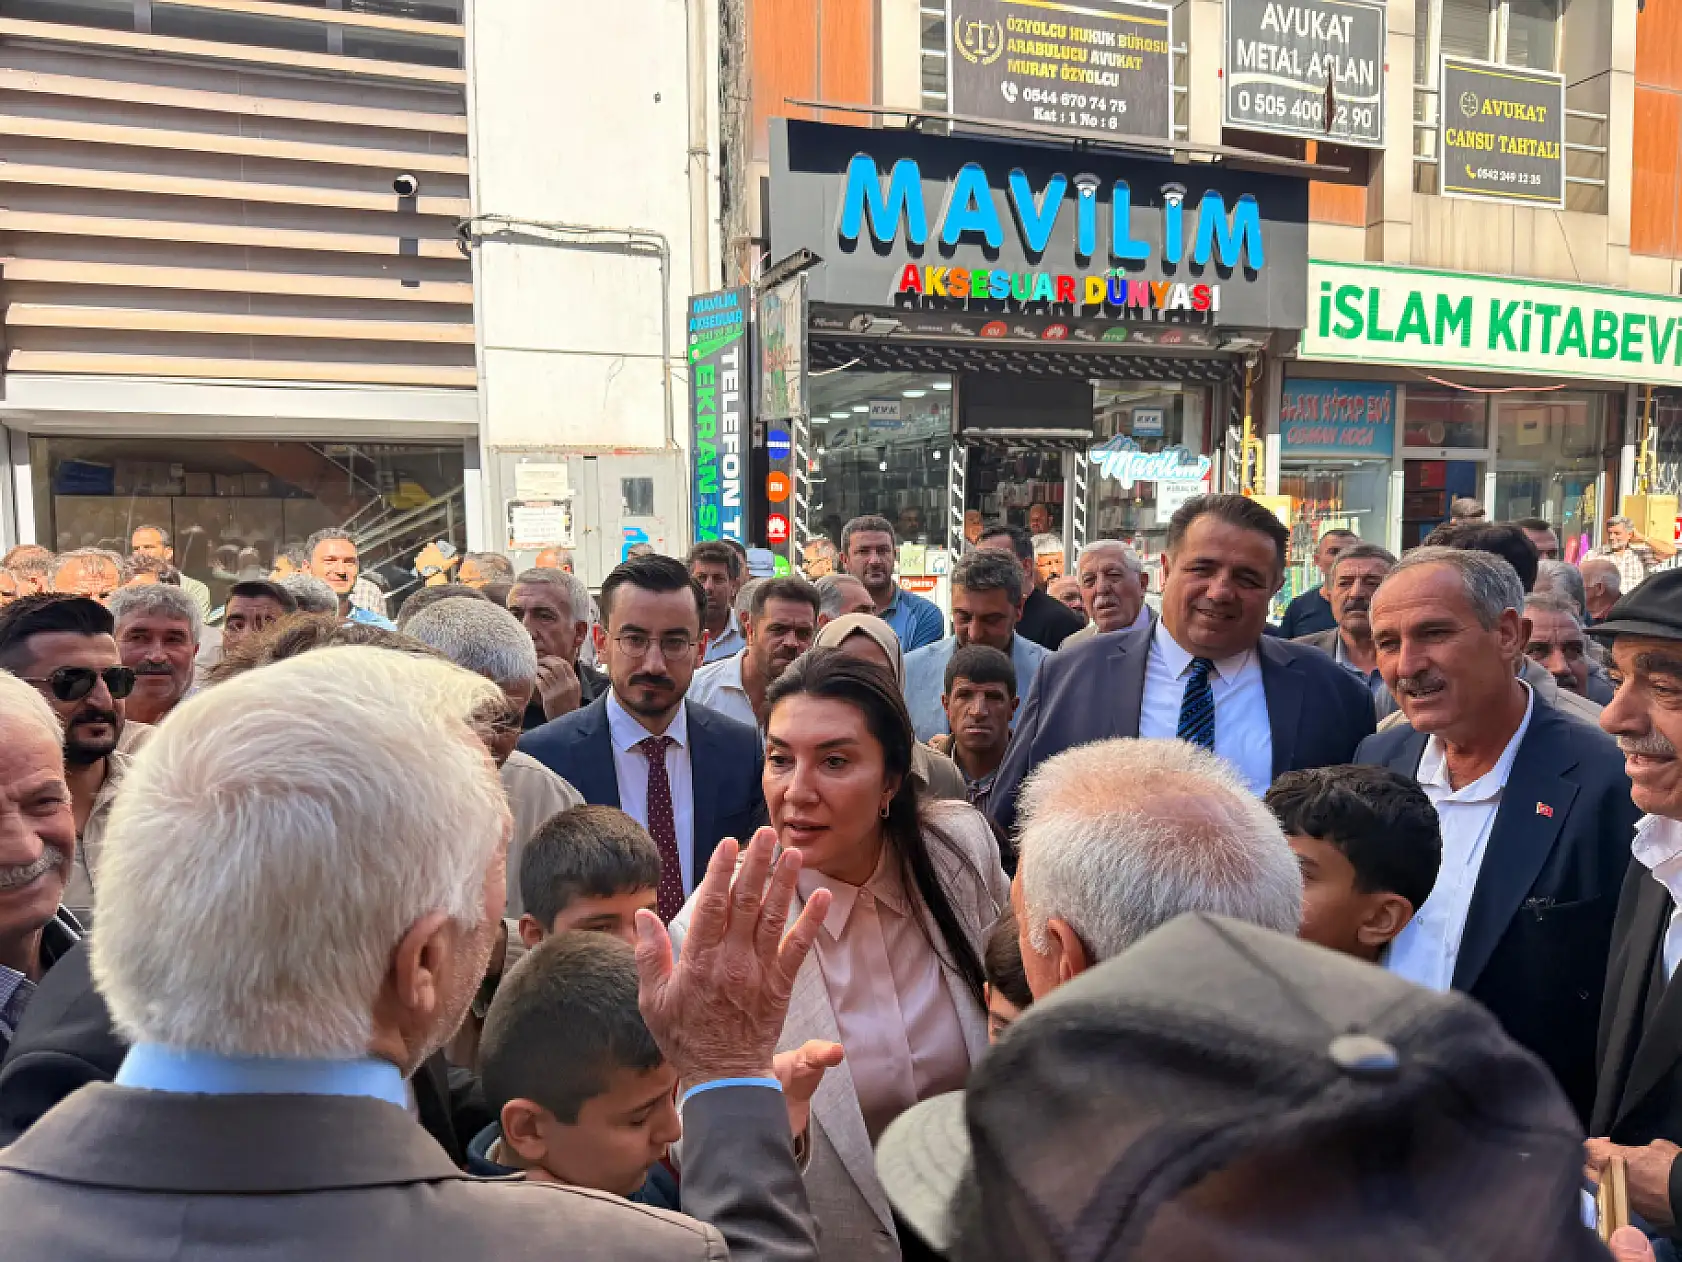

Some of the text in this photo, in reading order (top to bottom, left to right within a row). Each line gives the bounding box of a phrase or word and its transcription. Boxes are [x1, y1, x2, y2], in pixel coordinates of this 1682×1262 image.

[1006, 12, 1169, 55] ÖZYOLCU HUKUK BÜROSU
[1260, 1, 1354, 44] AVUKAT
[1006, 38, 1143, 71] ARABULUCU AVUKAT
[1007, 59, 1120, 88] MURAT ÖZYOLCU
[1236, 38, 1302, 76] METAL
[1022, 87, 1127, 113] 0544 670 74 75
[1033, 106, 1057, 123] Kat
[1079, 112, 1098, 128] No
[1237, 90, 1250, 112] 0
[1254, 93, 1287, 117] 505
[1289, 99, 1322, 122] 400
[1352, 108, 1372, 129] 90
[1481, 98, 1547, 123] AVUKAT
[1446, 128, 1560, 160] CANSU TAHTALI
[839, 152, 1265, 270] MAVİLİM
[898, 263, 1221, 312] AKSESUAR DÜNYASI
[1318, 281, 1682, 366] İSLAM KİTABEVİ
[695, 364, 718, 494] EKRAN
[721, 346, 741, 507] TELEFON
